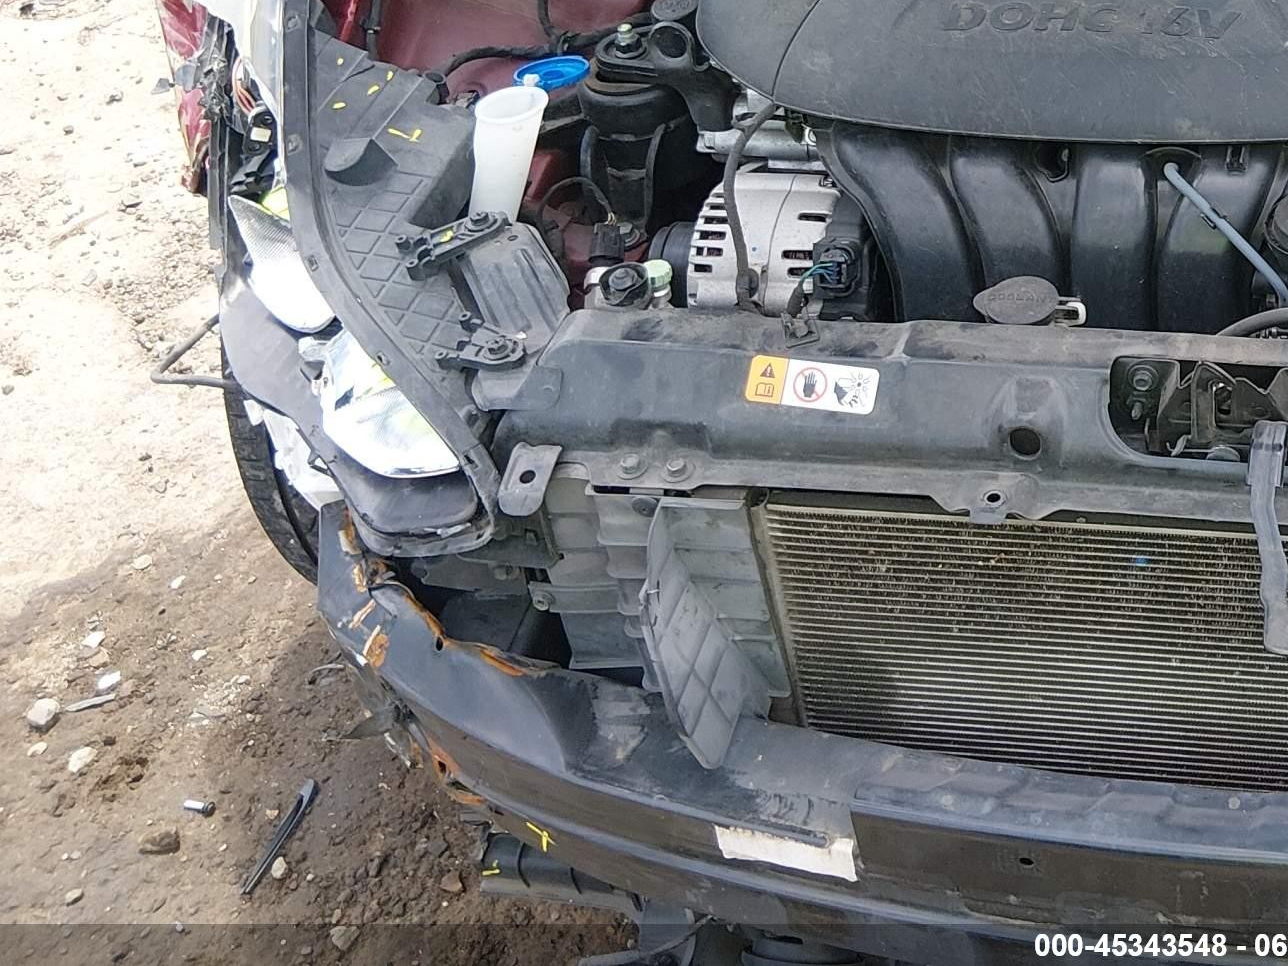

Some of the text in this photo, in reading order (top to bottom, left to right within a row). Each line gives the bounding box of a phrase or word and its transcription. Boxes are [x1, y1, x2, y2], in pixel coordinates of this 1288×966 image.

[943, 1, 1243, 39] DOHC 16V
[987, 292, 1055, 304] COOLANT
